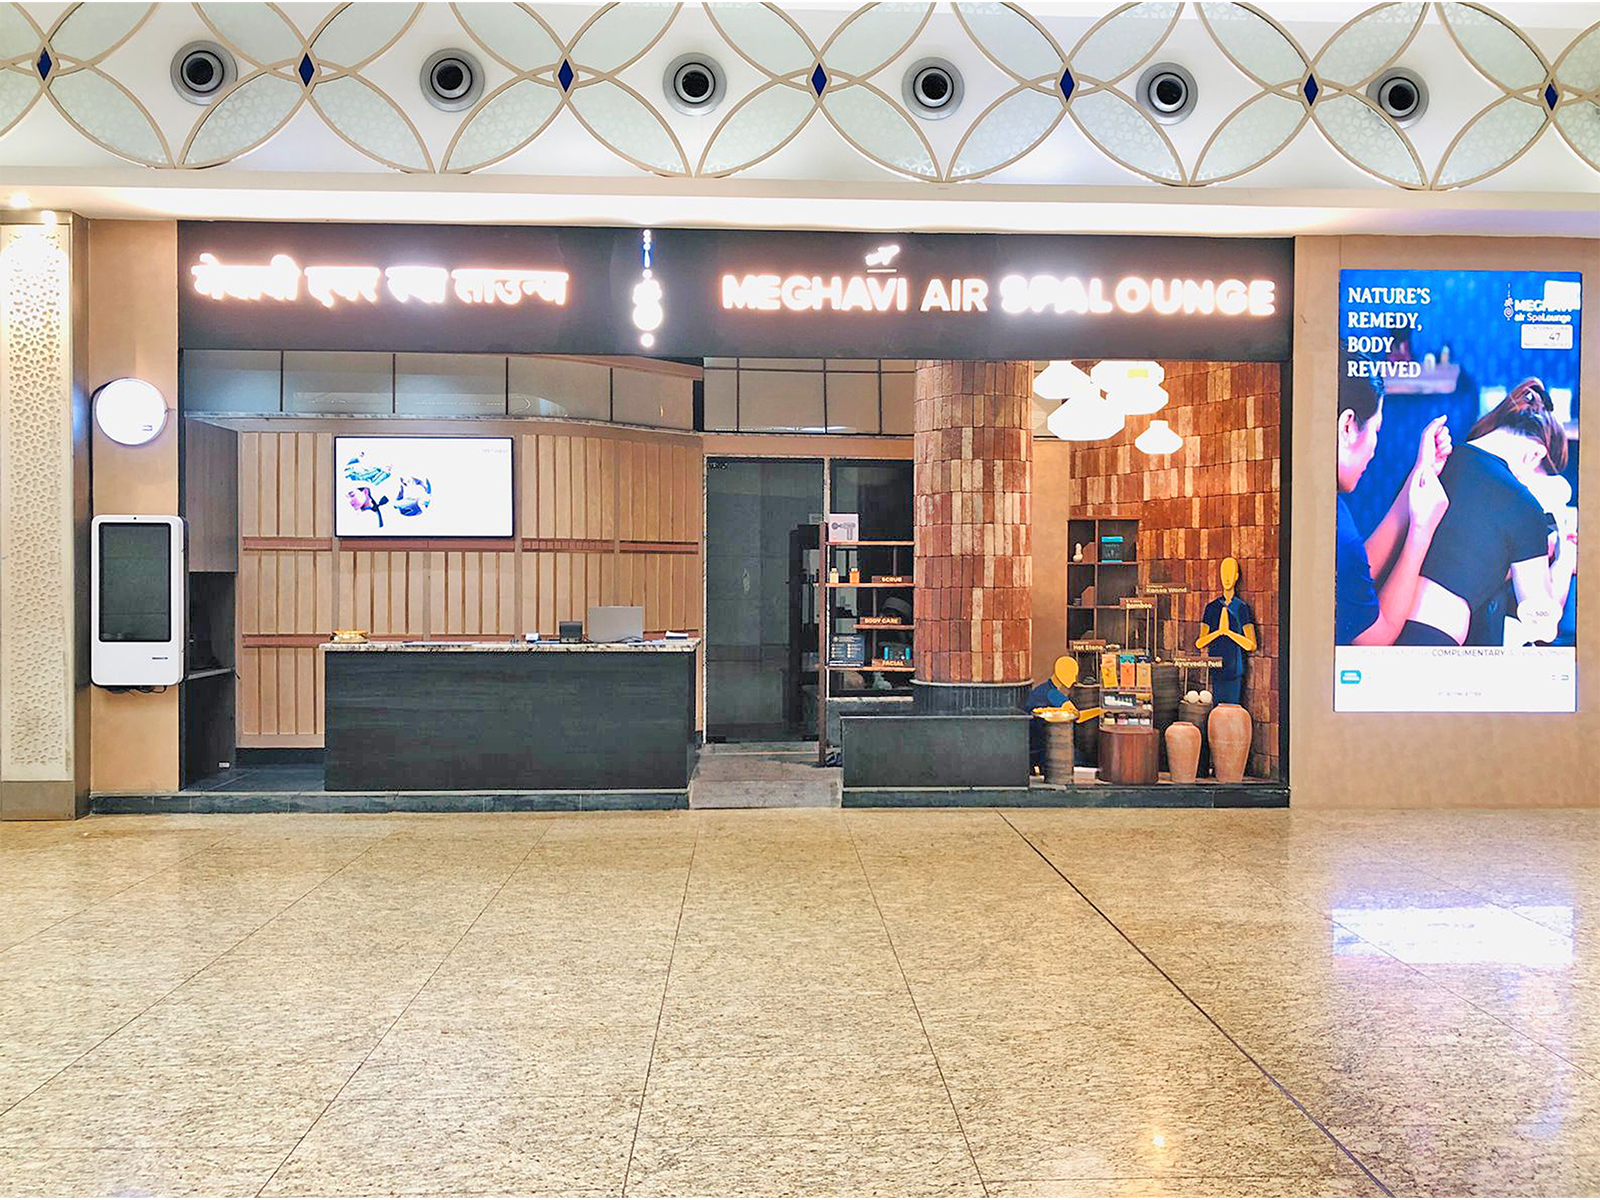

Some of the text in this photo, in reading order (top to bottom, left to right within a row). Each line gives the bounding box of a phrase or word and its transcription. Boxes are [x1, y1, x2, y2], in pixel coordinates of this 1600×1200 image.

[721, 275, 908, 311] MEGHAVI
[920, 278, 988, 312] AIR
[1347, 287, 1432, 304] NATURE'S
[1347, 311, 1423, 331] REMEDY,
[1347, 336, 1395, 353] BODY
[1347, 360, 1422, 378] REVIVED
[1431, 649, 1506, 657] COMPLIMENTARY
